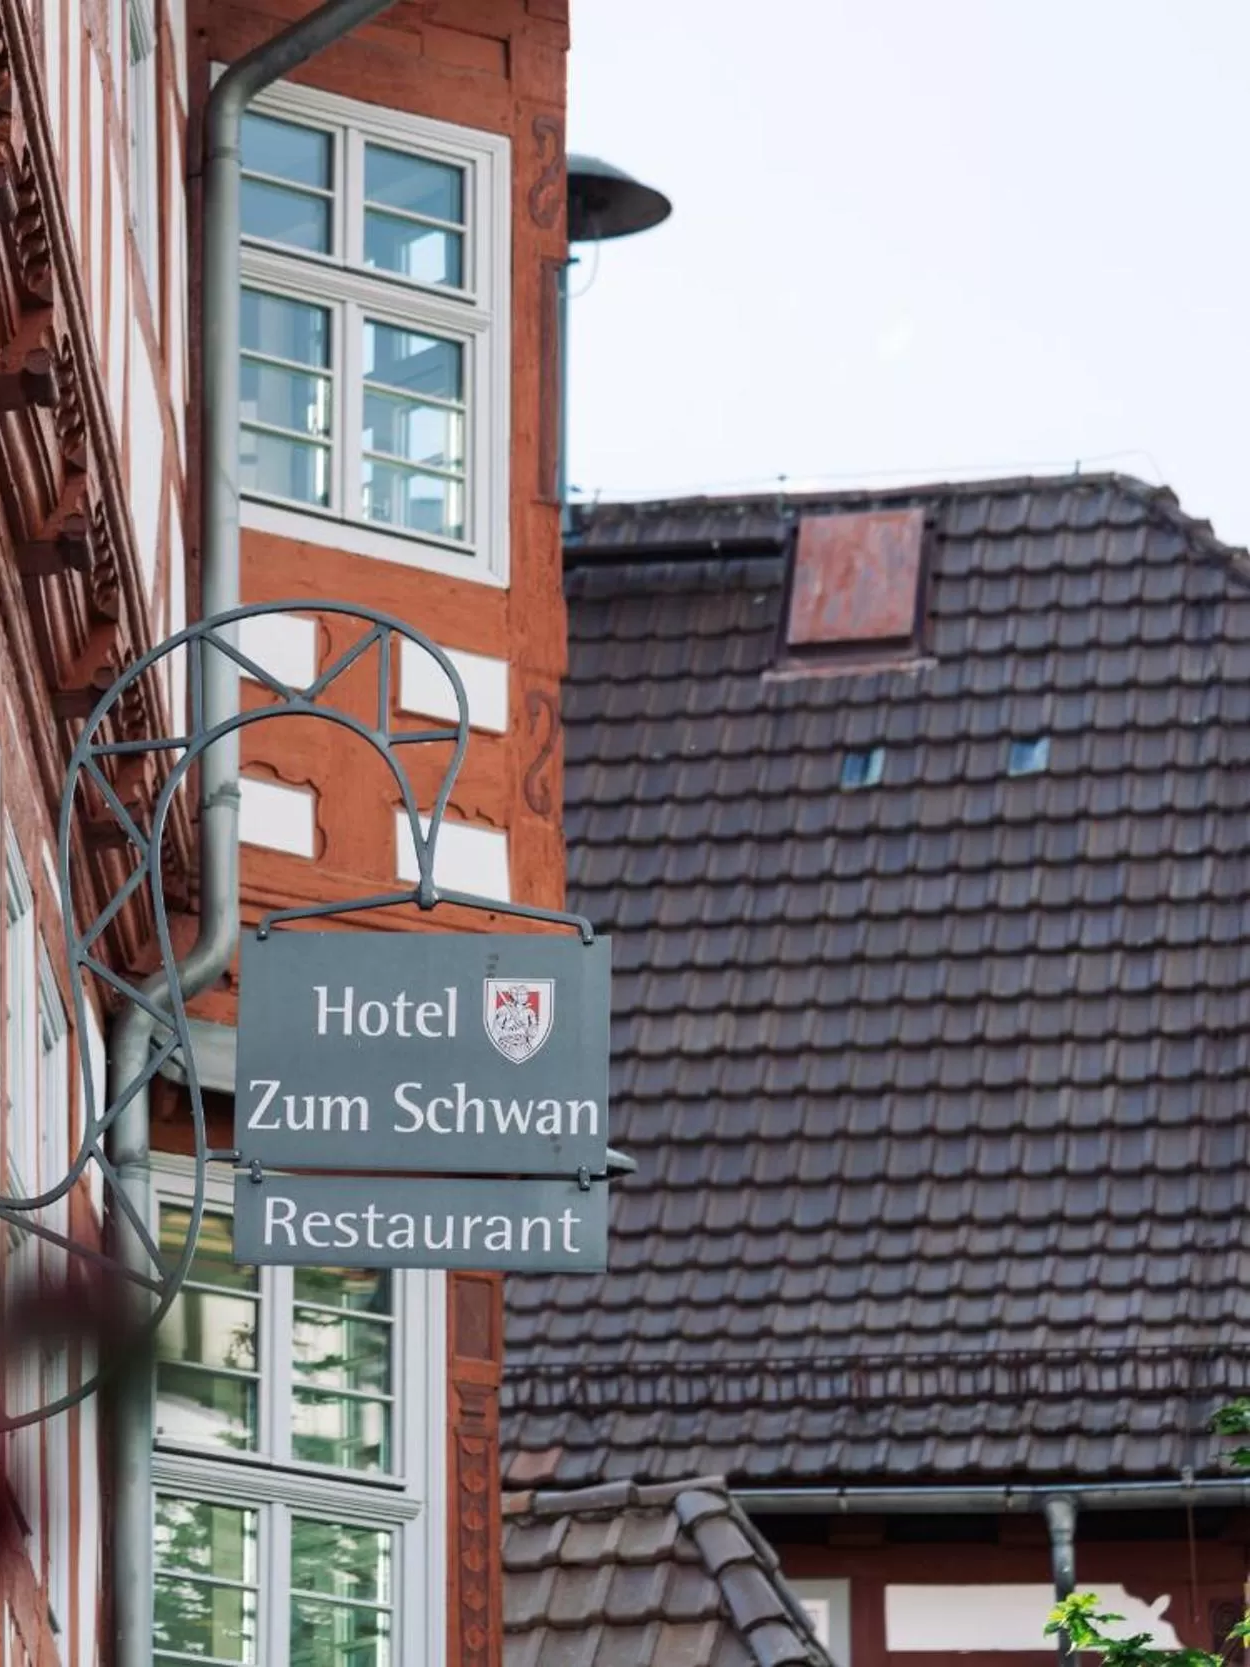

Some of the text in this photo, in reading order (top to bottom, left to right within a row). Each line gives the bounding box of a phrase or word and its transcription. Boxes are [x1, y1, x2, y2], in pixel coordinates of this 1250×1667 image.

[312, 985, 458, 1038] Hotel
[247, 1079, 599, 1136] Zum Schwan
[263, 1196, 582, 1253] Restaurant
